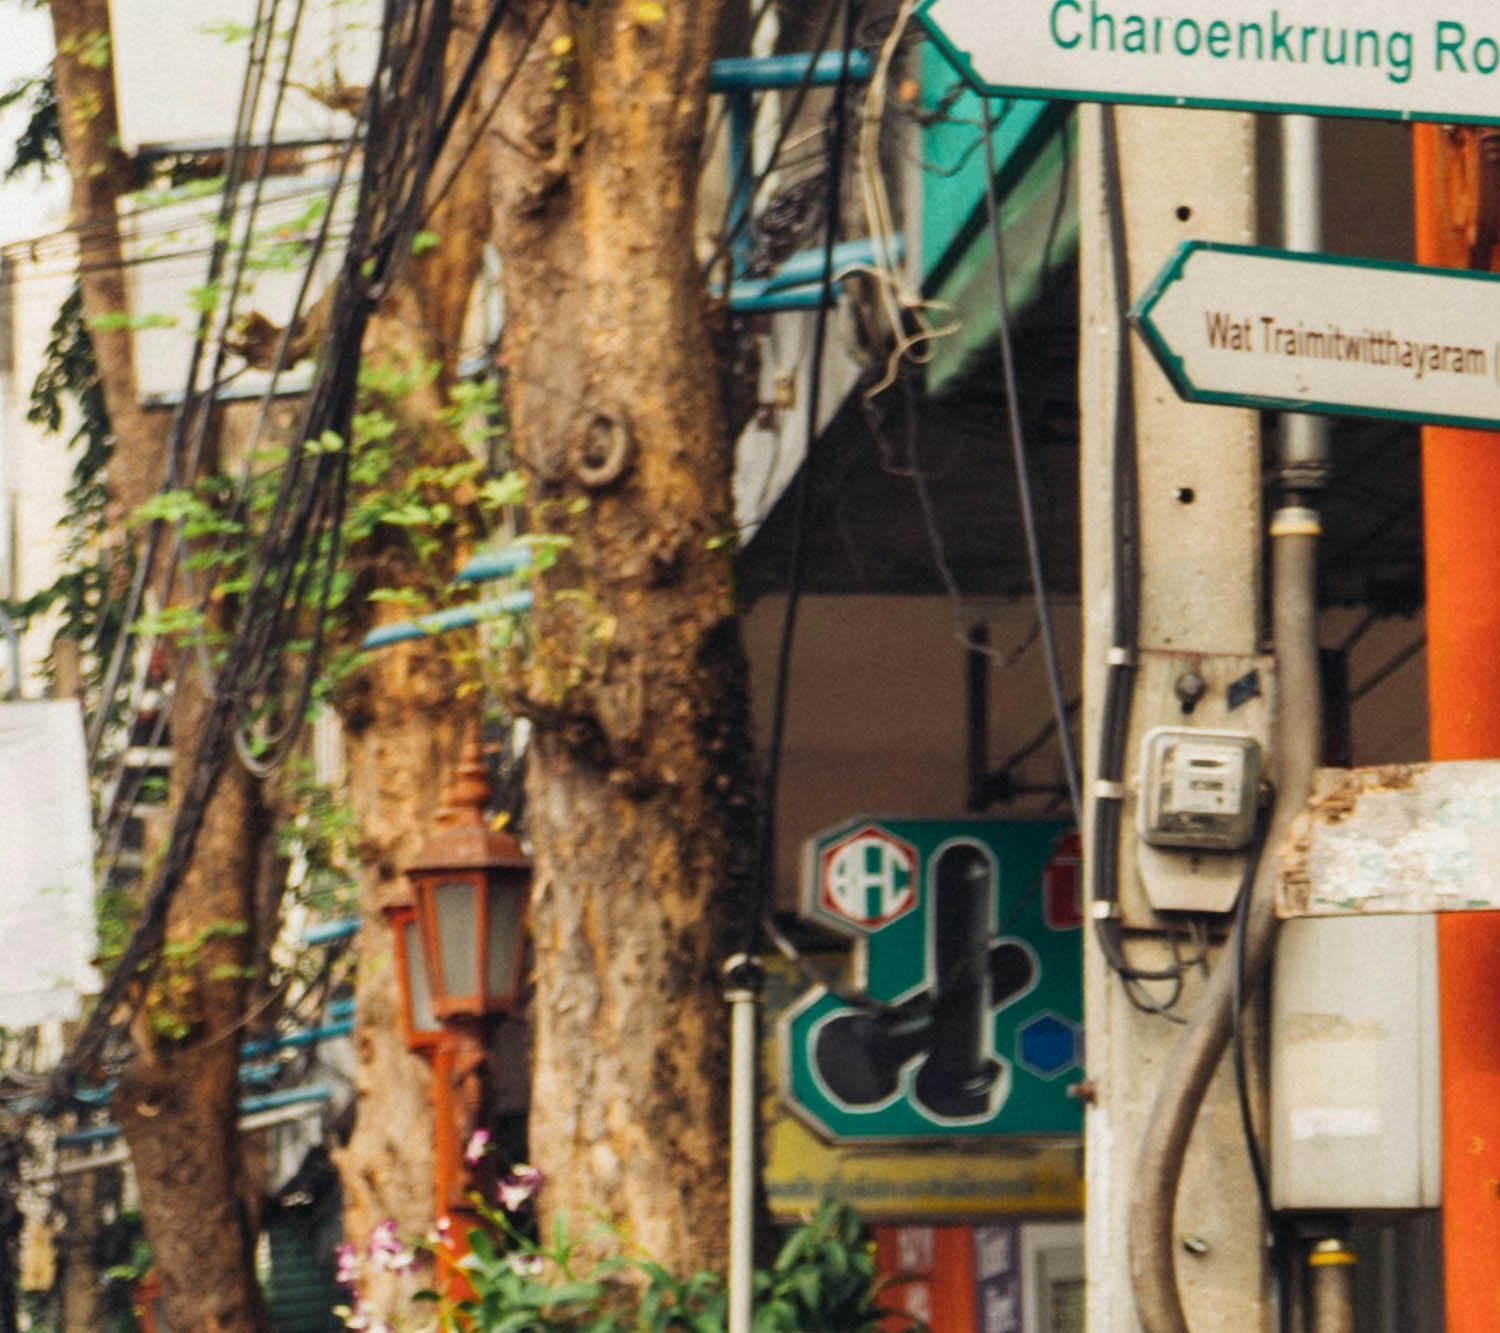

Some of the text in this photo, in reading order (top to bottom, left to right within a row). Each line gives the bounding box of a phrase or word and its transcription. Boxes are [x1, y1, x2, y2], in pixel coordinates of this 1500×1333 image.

[1049, 0, 1412, 83] Charoenkrung
[1206, 311, 1253, 352] Wat
[1260, 316, 1487, 380] Traimitwitthayaram
